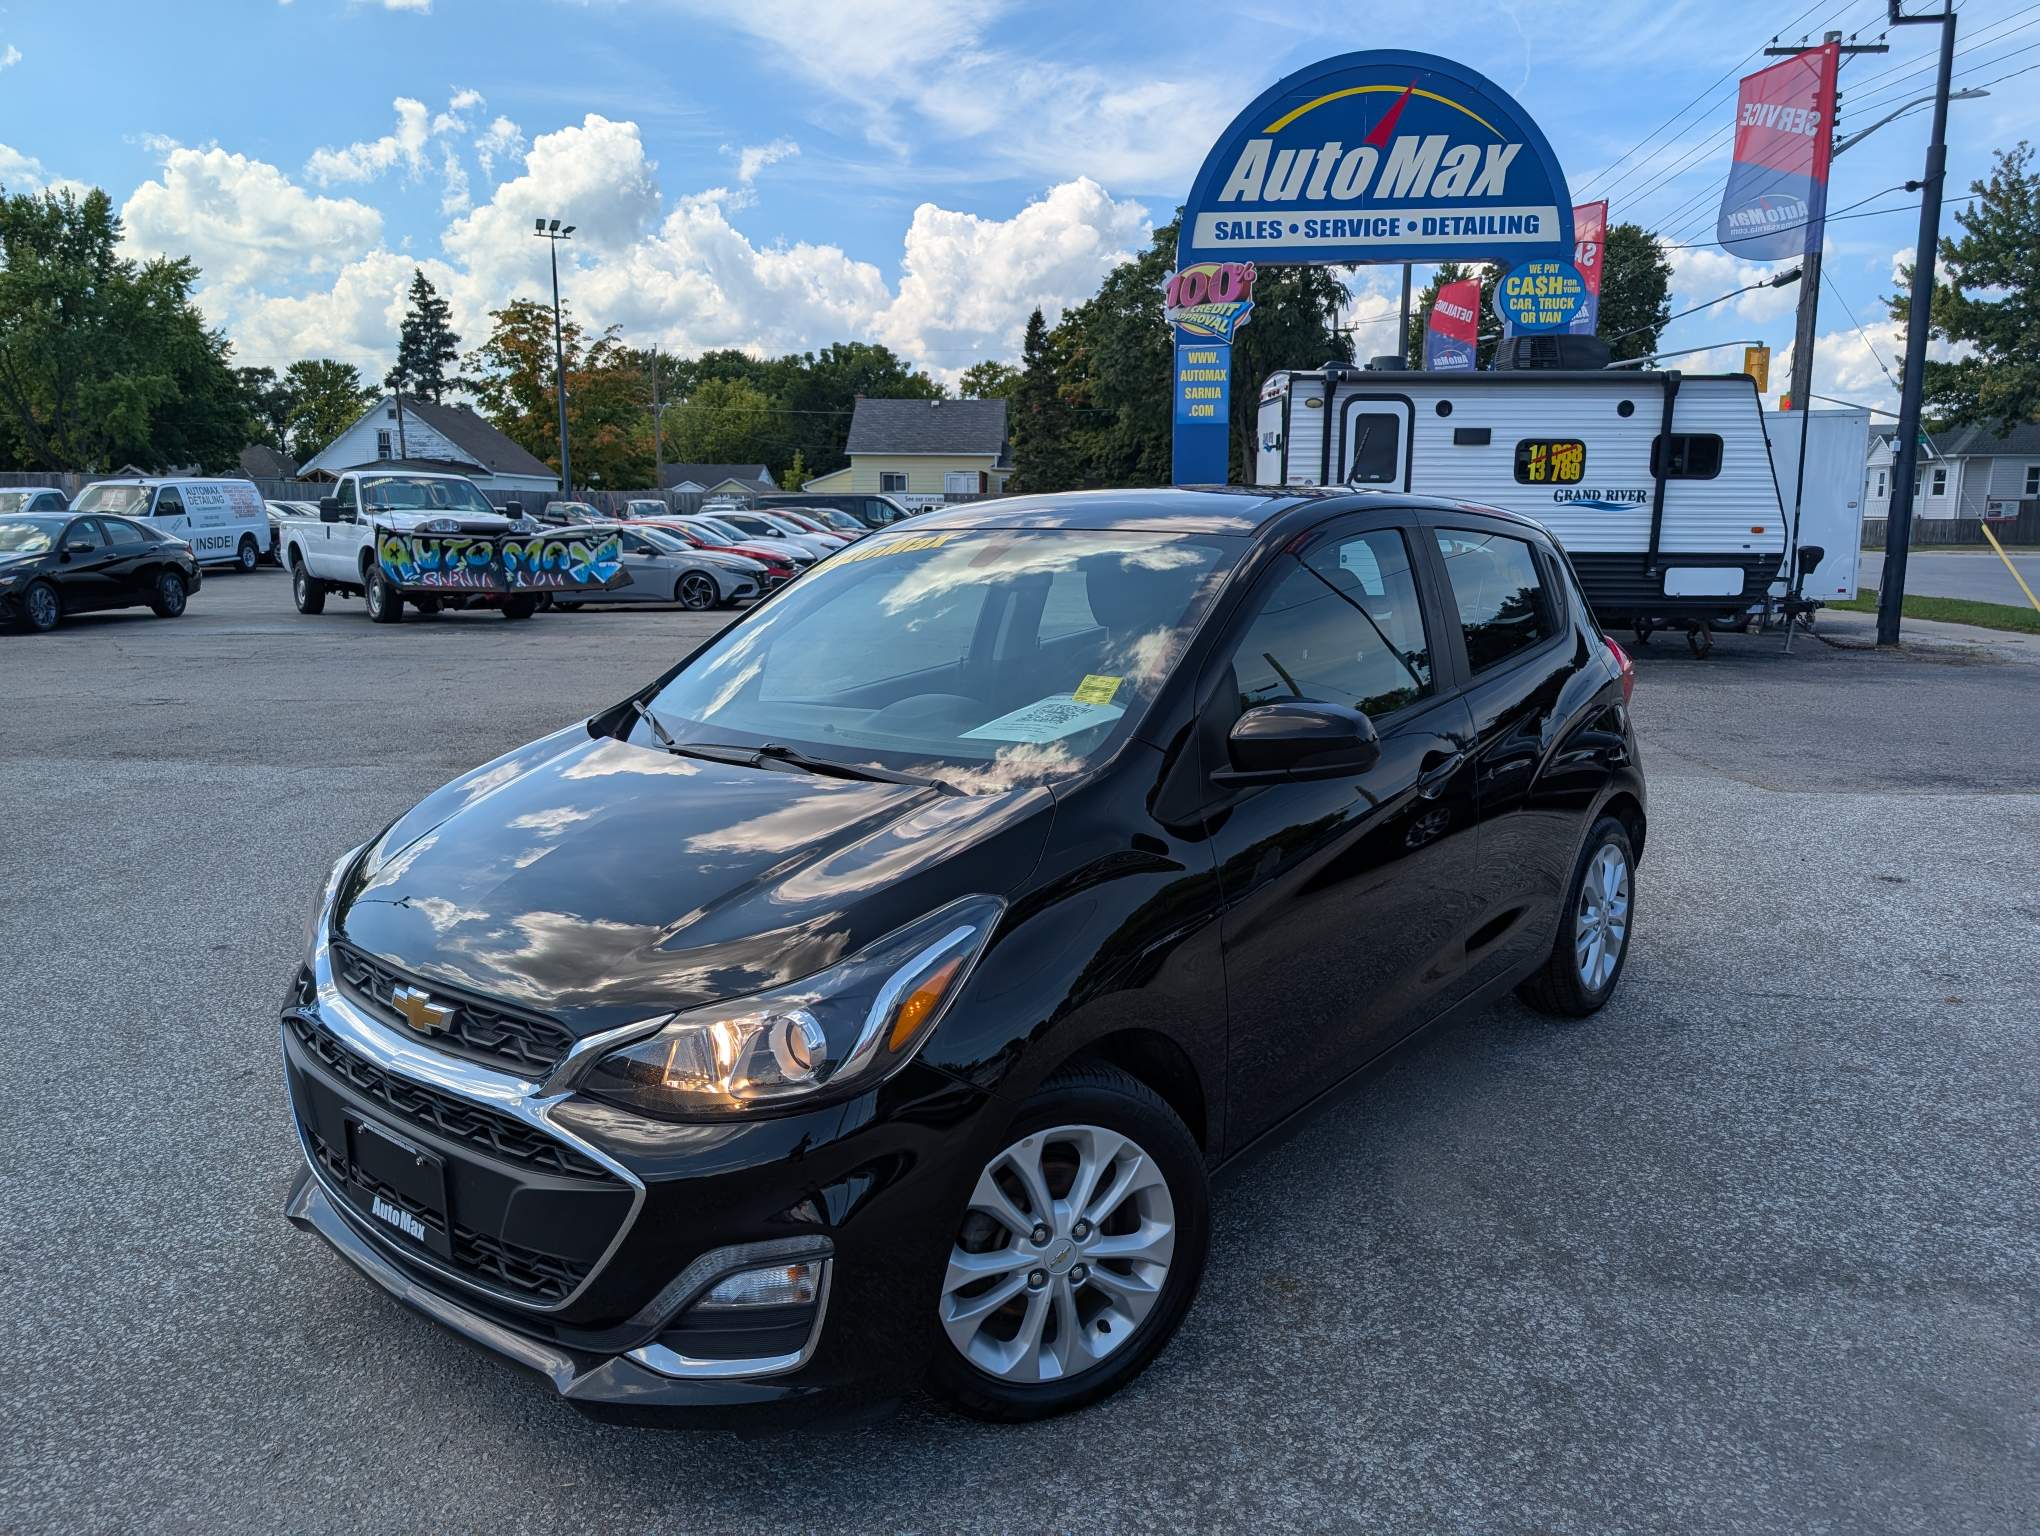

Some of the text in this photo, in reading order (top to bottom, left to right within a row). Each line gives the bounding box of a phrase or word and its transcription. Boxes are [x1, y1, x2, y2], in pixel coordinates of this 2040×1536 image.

[1214, 214, 1540, 241] SALES SERVICE DETAILING
[1529, 264, 1560, 274] WE PAY
[1167, 262, 1256, 309] 100%
[1506, 275, 1563, 297] CA$H
[1191, 302, 1241, 318] CREDIT
[1510, 297, 1575, 311] CAR, TRUCK
[1521, 311, 1536, 323] OR
[1539, 311, 1562, 323] VAN
[1188, 351, 1220, 364] WWW.
[1180, 369, 1227, 382] AUTOMAX
[1184, 387, 1222, 399] SARNIA
[1188, 404, 1214, 417] .COM
[1528, 462, 1580, 481] 13 789
[186, 485, 220, 496] AUTOMAX
[1553, 488, 1648, 504] GRAND RIVER
[187, 495, 225, 506] DETAILING
[196, 535, 234, 552] INSIDE!
[371, 1195, 426, 1242] AutoMax
